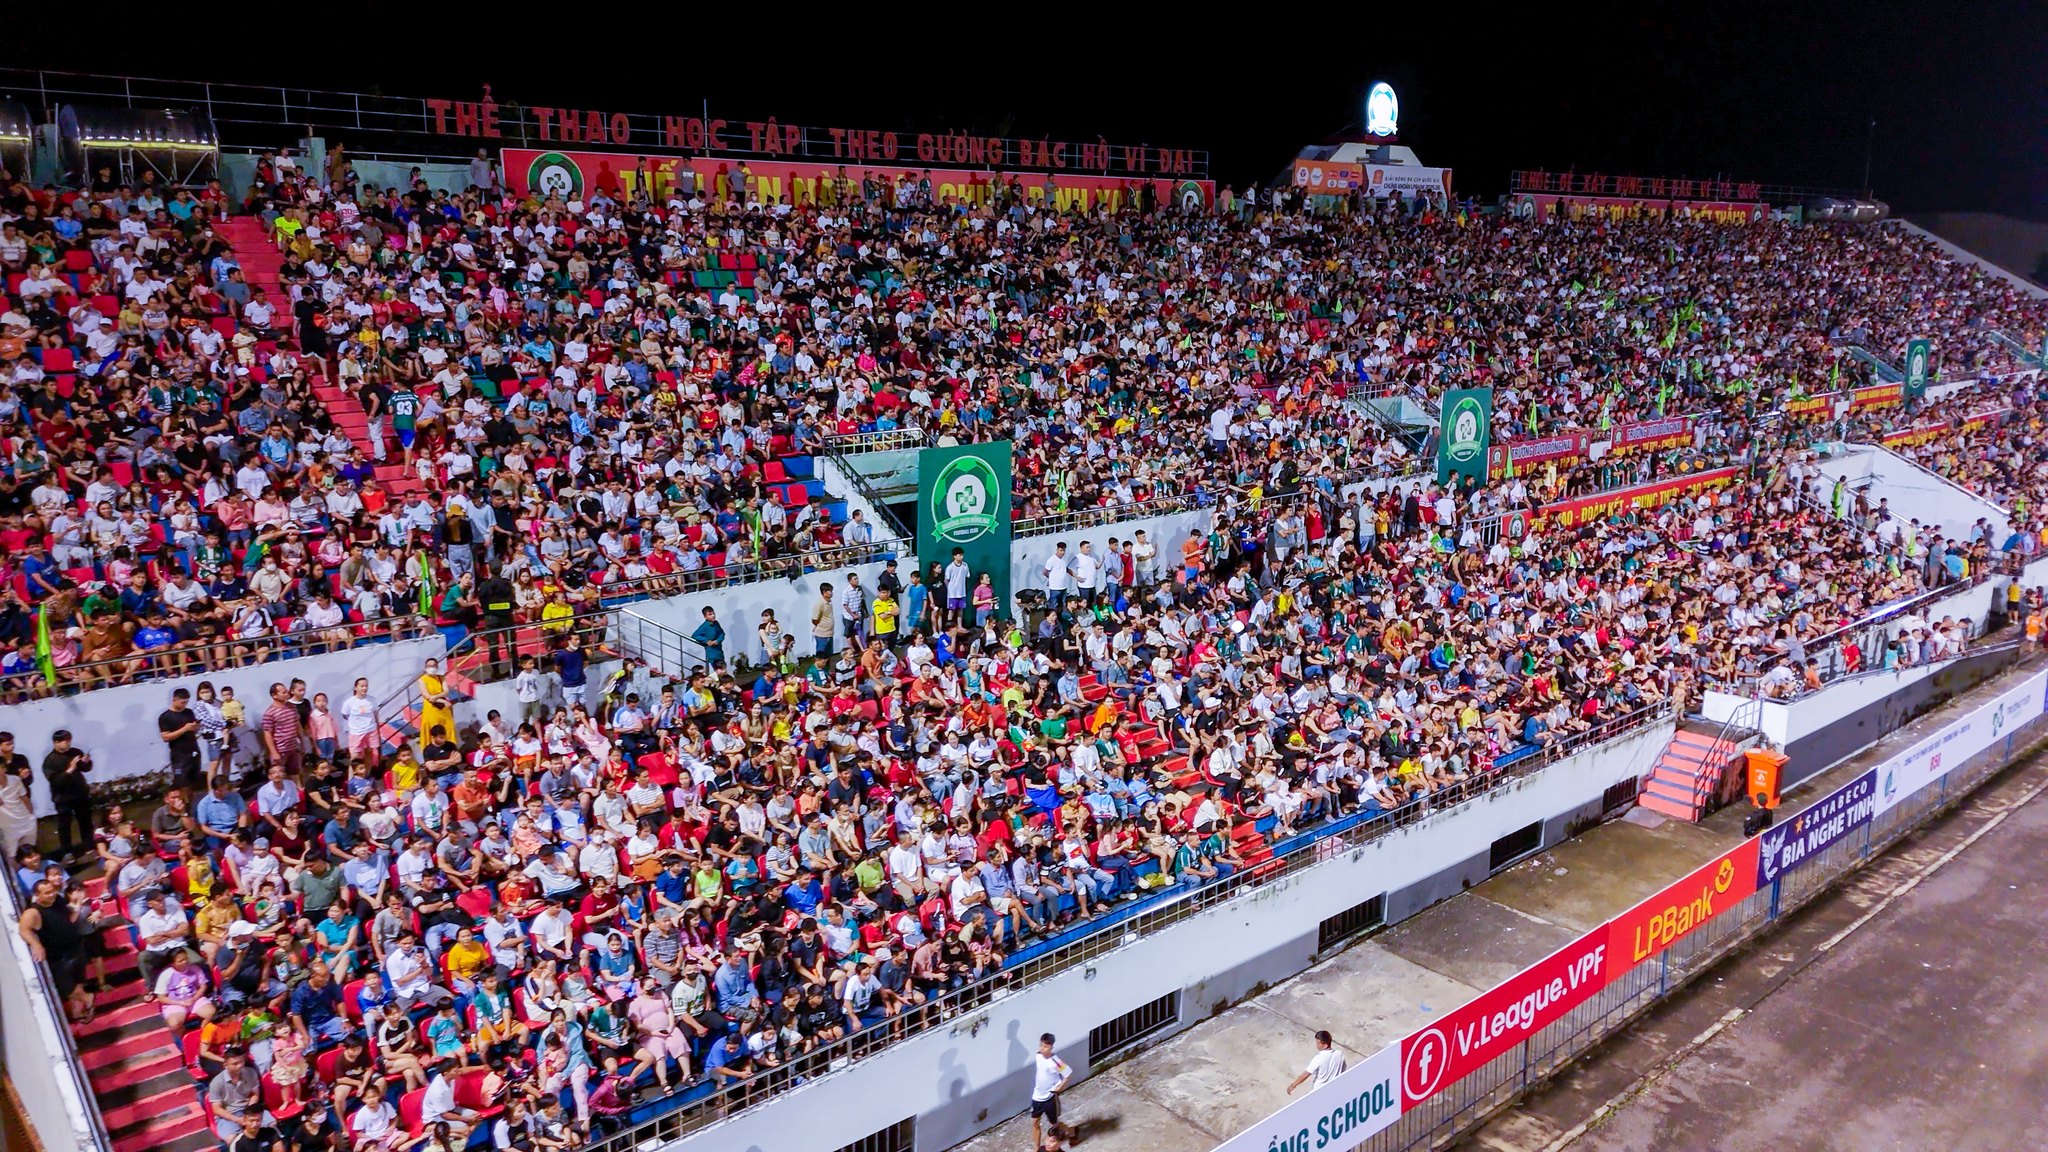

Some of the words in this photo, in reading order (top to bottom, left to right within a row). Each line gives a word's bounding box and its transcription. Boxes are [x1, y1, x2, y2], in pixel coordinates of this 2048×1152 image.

[427, 82, 501, 138] THỂ
[532, 107, 629, 144] THAO
[665, 115, 728, 154] HỌC
[746, 115, 801, 157] TẬP
[828, 128, 898, 160] THEO
[1020, 132, 1067, 169] BÁC
[397, 401, 413, 415] 93
[1782, 837, 1806, 869] BIA
[1808, 815, 1845, 853] NGHE
[1846, 793, 1876, 828] TINH
[1805, 781, 1868, 829] SAVABECO
[1633, 886, 1714, 963] LPBank
[1457, 944, 1606, 1057] V.League.VPF
[1317, 1078, 1395, 1149] SCHOOL
